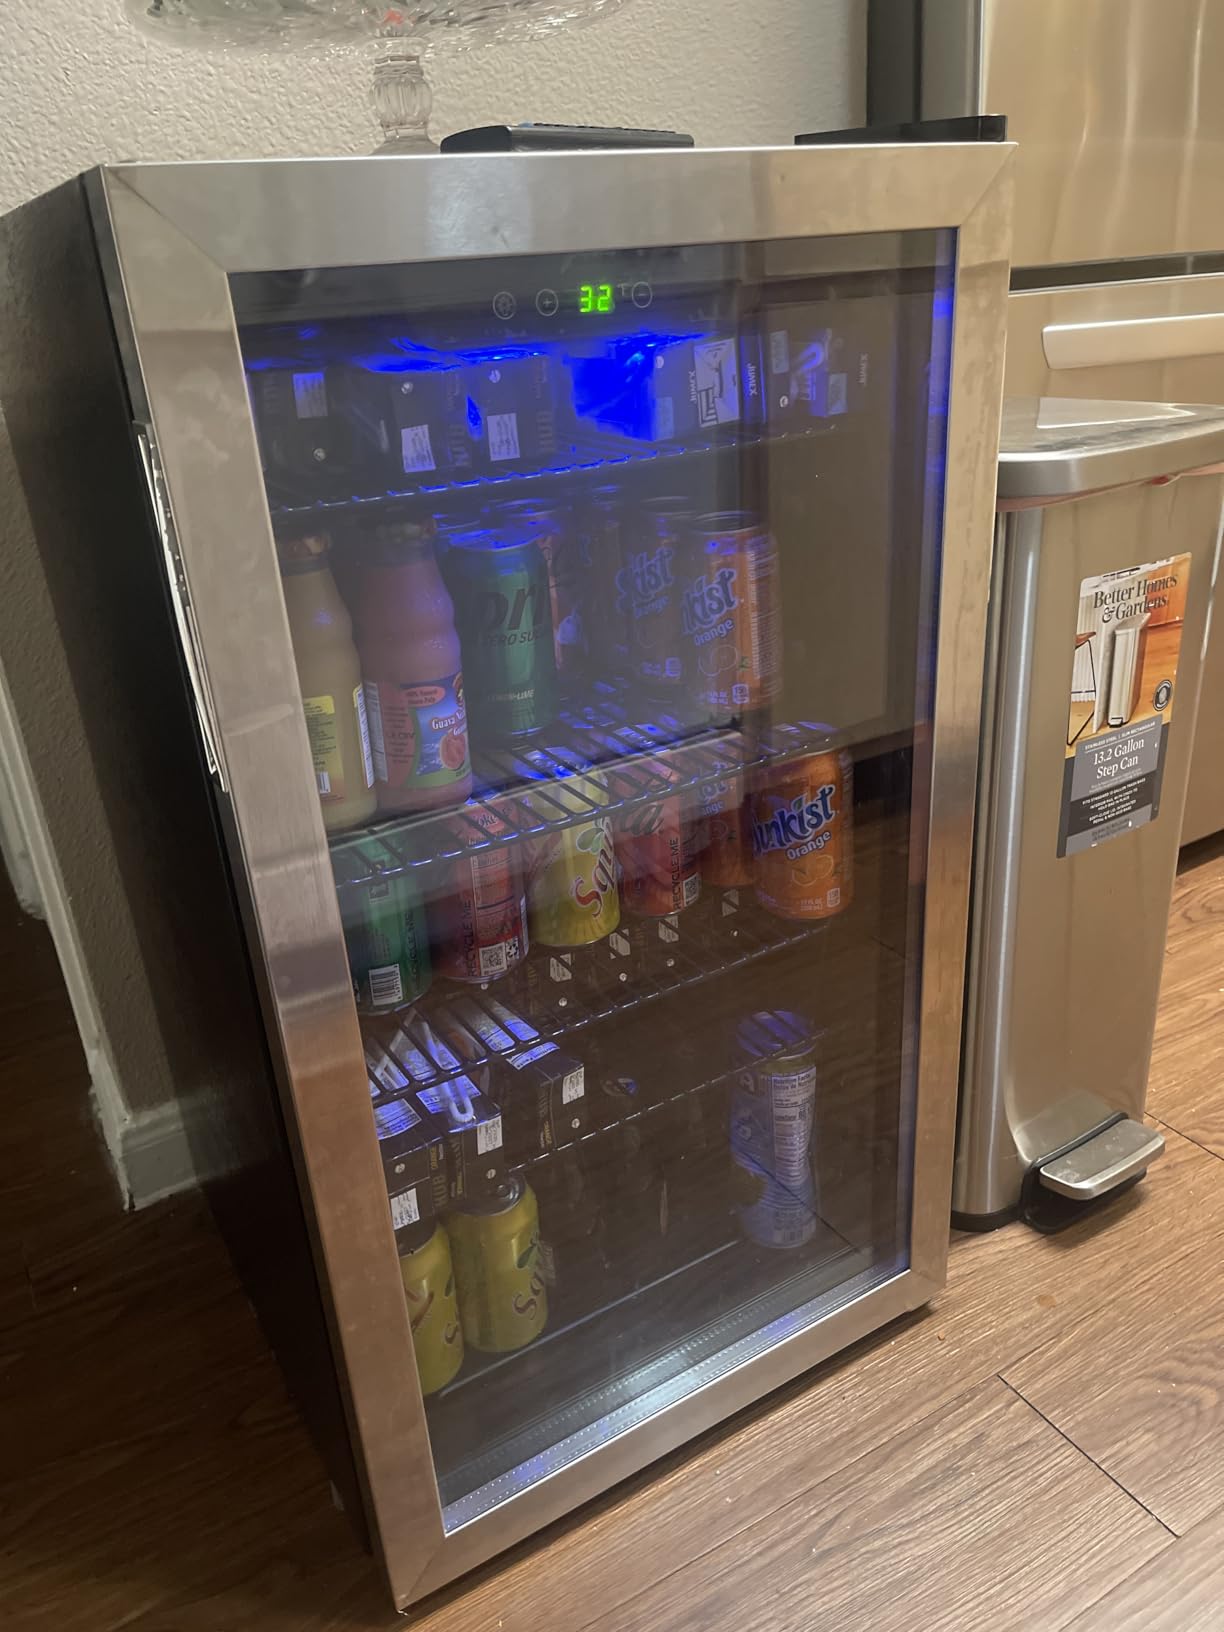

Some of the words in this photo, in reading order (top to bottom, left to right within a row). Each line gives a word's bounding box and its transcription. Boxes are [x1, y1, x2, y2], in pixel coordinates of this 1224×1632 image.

[579, 284, 611, 313] 32
[1093, 585, 1136, 609] Better
[1136, 576, 1178, 599] Homes
[431, 716, 456, 731] Guava
[1093, 748, 1112, 766] 13.2
[1114, 738, 1145, 759] Gallon
[1096, 763, 1119, 779] Step
[1120, 755, 1139, 773] Can
[670, 837, 681, 857] ME
[787, 831, 832, 860] Orange
[671, 858, 682, 910] RECYCLE
